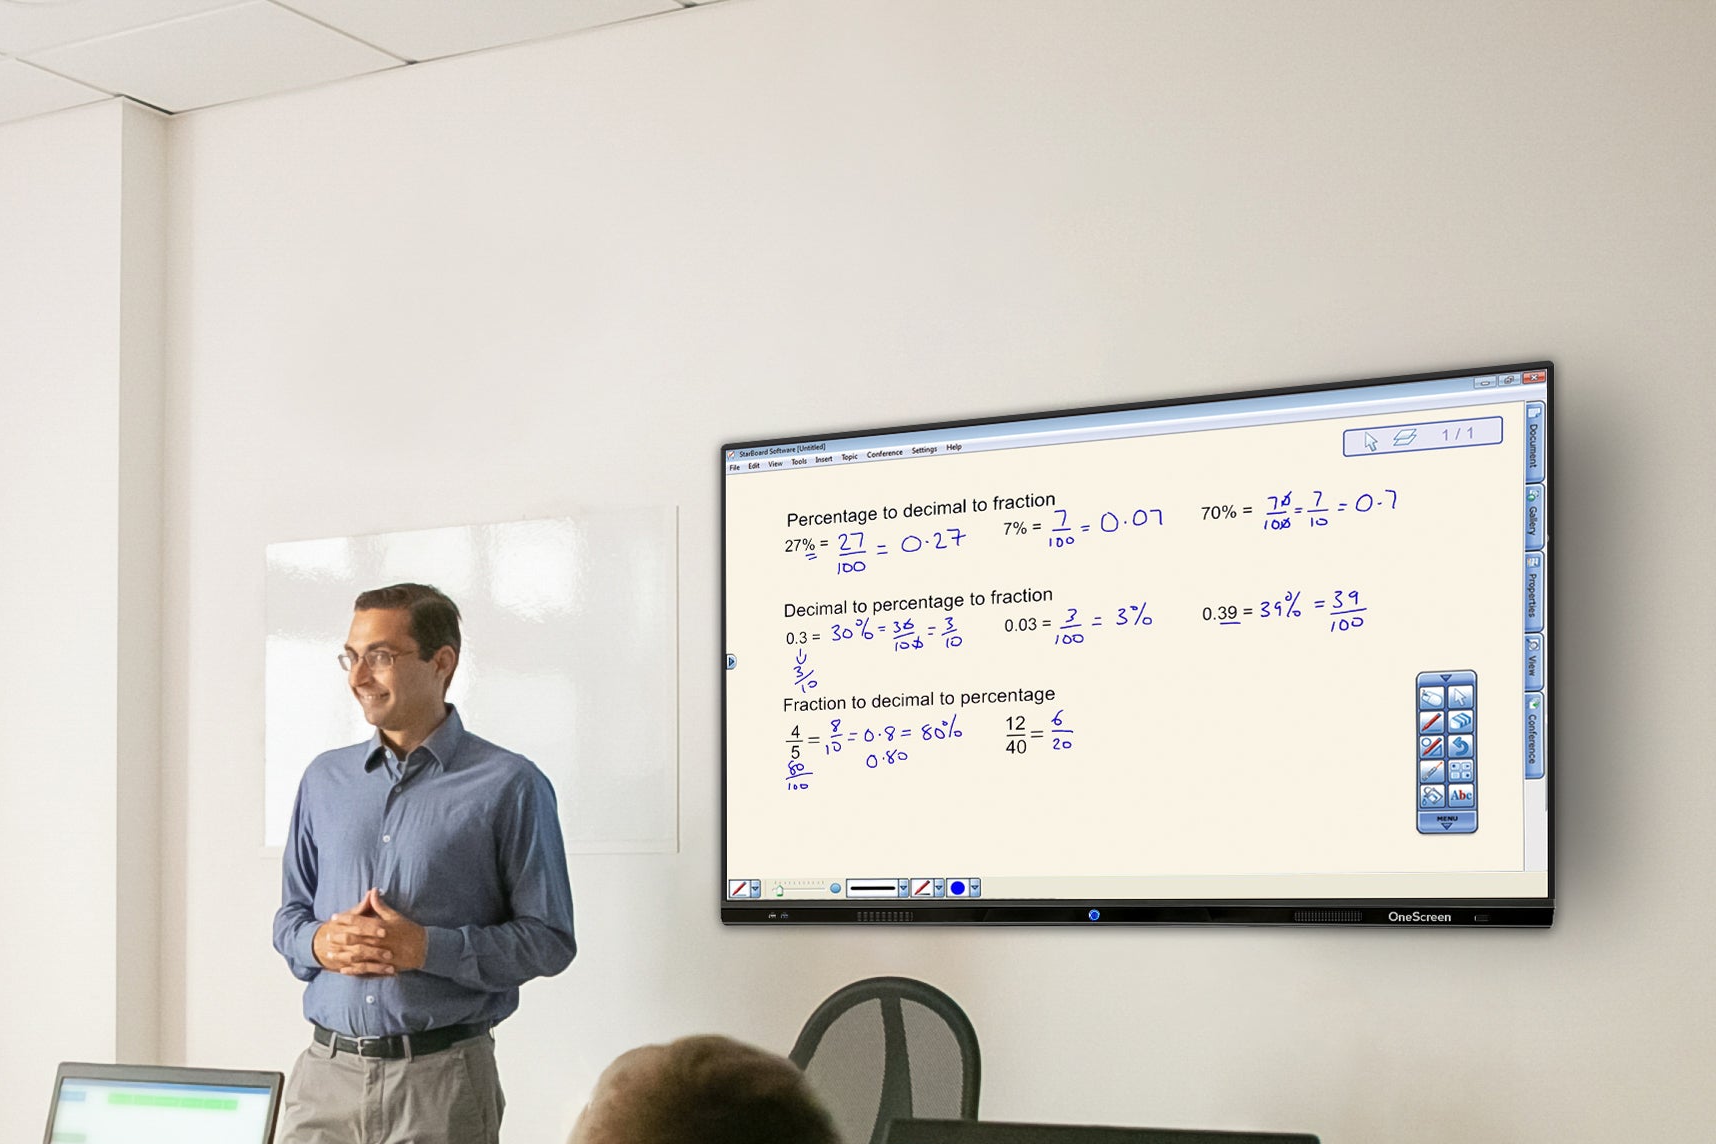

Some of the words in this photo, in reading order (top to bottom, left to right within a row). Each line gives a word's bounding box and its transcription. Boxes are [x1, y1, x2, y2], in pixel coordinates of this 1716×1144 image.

[739, 449, 768, 458] StarBoard
[769, 446, 796, 455] Software
[797, 443, 826, 453] [Untitled]
[1529, 424, 1538, 468] Document
[768, 460, 783, 468] View
[791, 458, 807, 466] Tools
[841, 453, 858, 461] Topic
[866, 449, 903, 458] Conference
[911, 446, 937, 455] Settings
[787, 509, 878, 527] Percentage
[883, 506, 898, 520] to
[903, 498, 966, 518] decimal
[972, 498, 988, 512] to
[992, 493, 1055, 511] fraction
[1201, 504, 1237, 520] 70%
[1313, 490, 1322, 507] 7
[1003, 521, 1027, 535] 7%
[1054, 509, 1067, 527] 7
[1310, 517, 1328, 527] 10
[1528, 506, 1537, 536] Gallery
[785, 538, 816, 553] 27%
[838, 532, 864, 551] 27
[1049, 536, 1075, 548] 100
[837, 561, 866, 575] 100
[784, 600, 847, 618] Decimal
[852, 600, 867, 614] to
[873, 595, 964, 616] percentage
[969, 592, 985, 606] to
[990, 587, 1053, 605] fraction
[1202, 605, 1238, 621] 0.39
[1260, 591, 1301, 618] 39%
[1332, 590, 1359, 609] 39
[1528, 573, 1537, 618] Properties
[1004, 617, 1037, 633] 0.03
[1065, 608, 1077, 623] 3
[1116, 602, 1153, 626] 3%
[1330, 617, 1364, 632] 100
[786, 631, 808, 645] 0.3
[831, 617, 874, 641] 30%
[944, 616, 954, 631] 3
[1055, 634, 1084, 645] 100
[946, 636, 963, 649] 10
[1528, 655, 1536, 676] View
[784, 696, 846, 712] Fraction
[851, 696, 867, 709] to
[871, 691, 934, 708] decimal
[939, 691, 955, 705] to
[961, 688, 1055, 708] percentage
[791, 724, 800, 739] 4
[830, 718, 841, 733] 8
[921, 713, 963, 741] 80%
[1006, 715, 1026, 731] 12
[1051, 709, 1064, 726] 6
[825, 741, 842, 755] 10
[1005, 739, 1027, 754] 40
[1052, 738, 1072, 750] 20
[1528, 713, 1537, 764] Conference
[791, 745, 800, 760] 5
[788, 760, 805, 775] 80
[788, 782, 809, 790] 100
[1450, 789, 1472, 801] Abc
[1388, 911, 1451, 922] OneScreen
